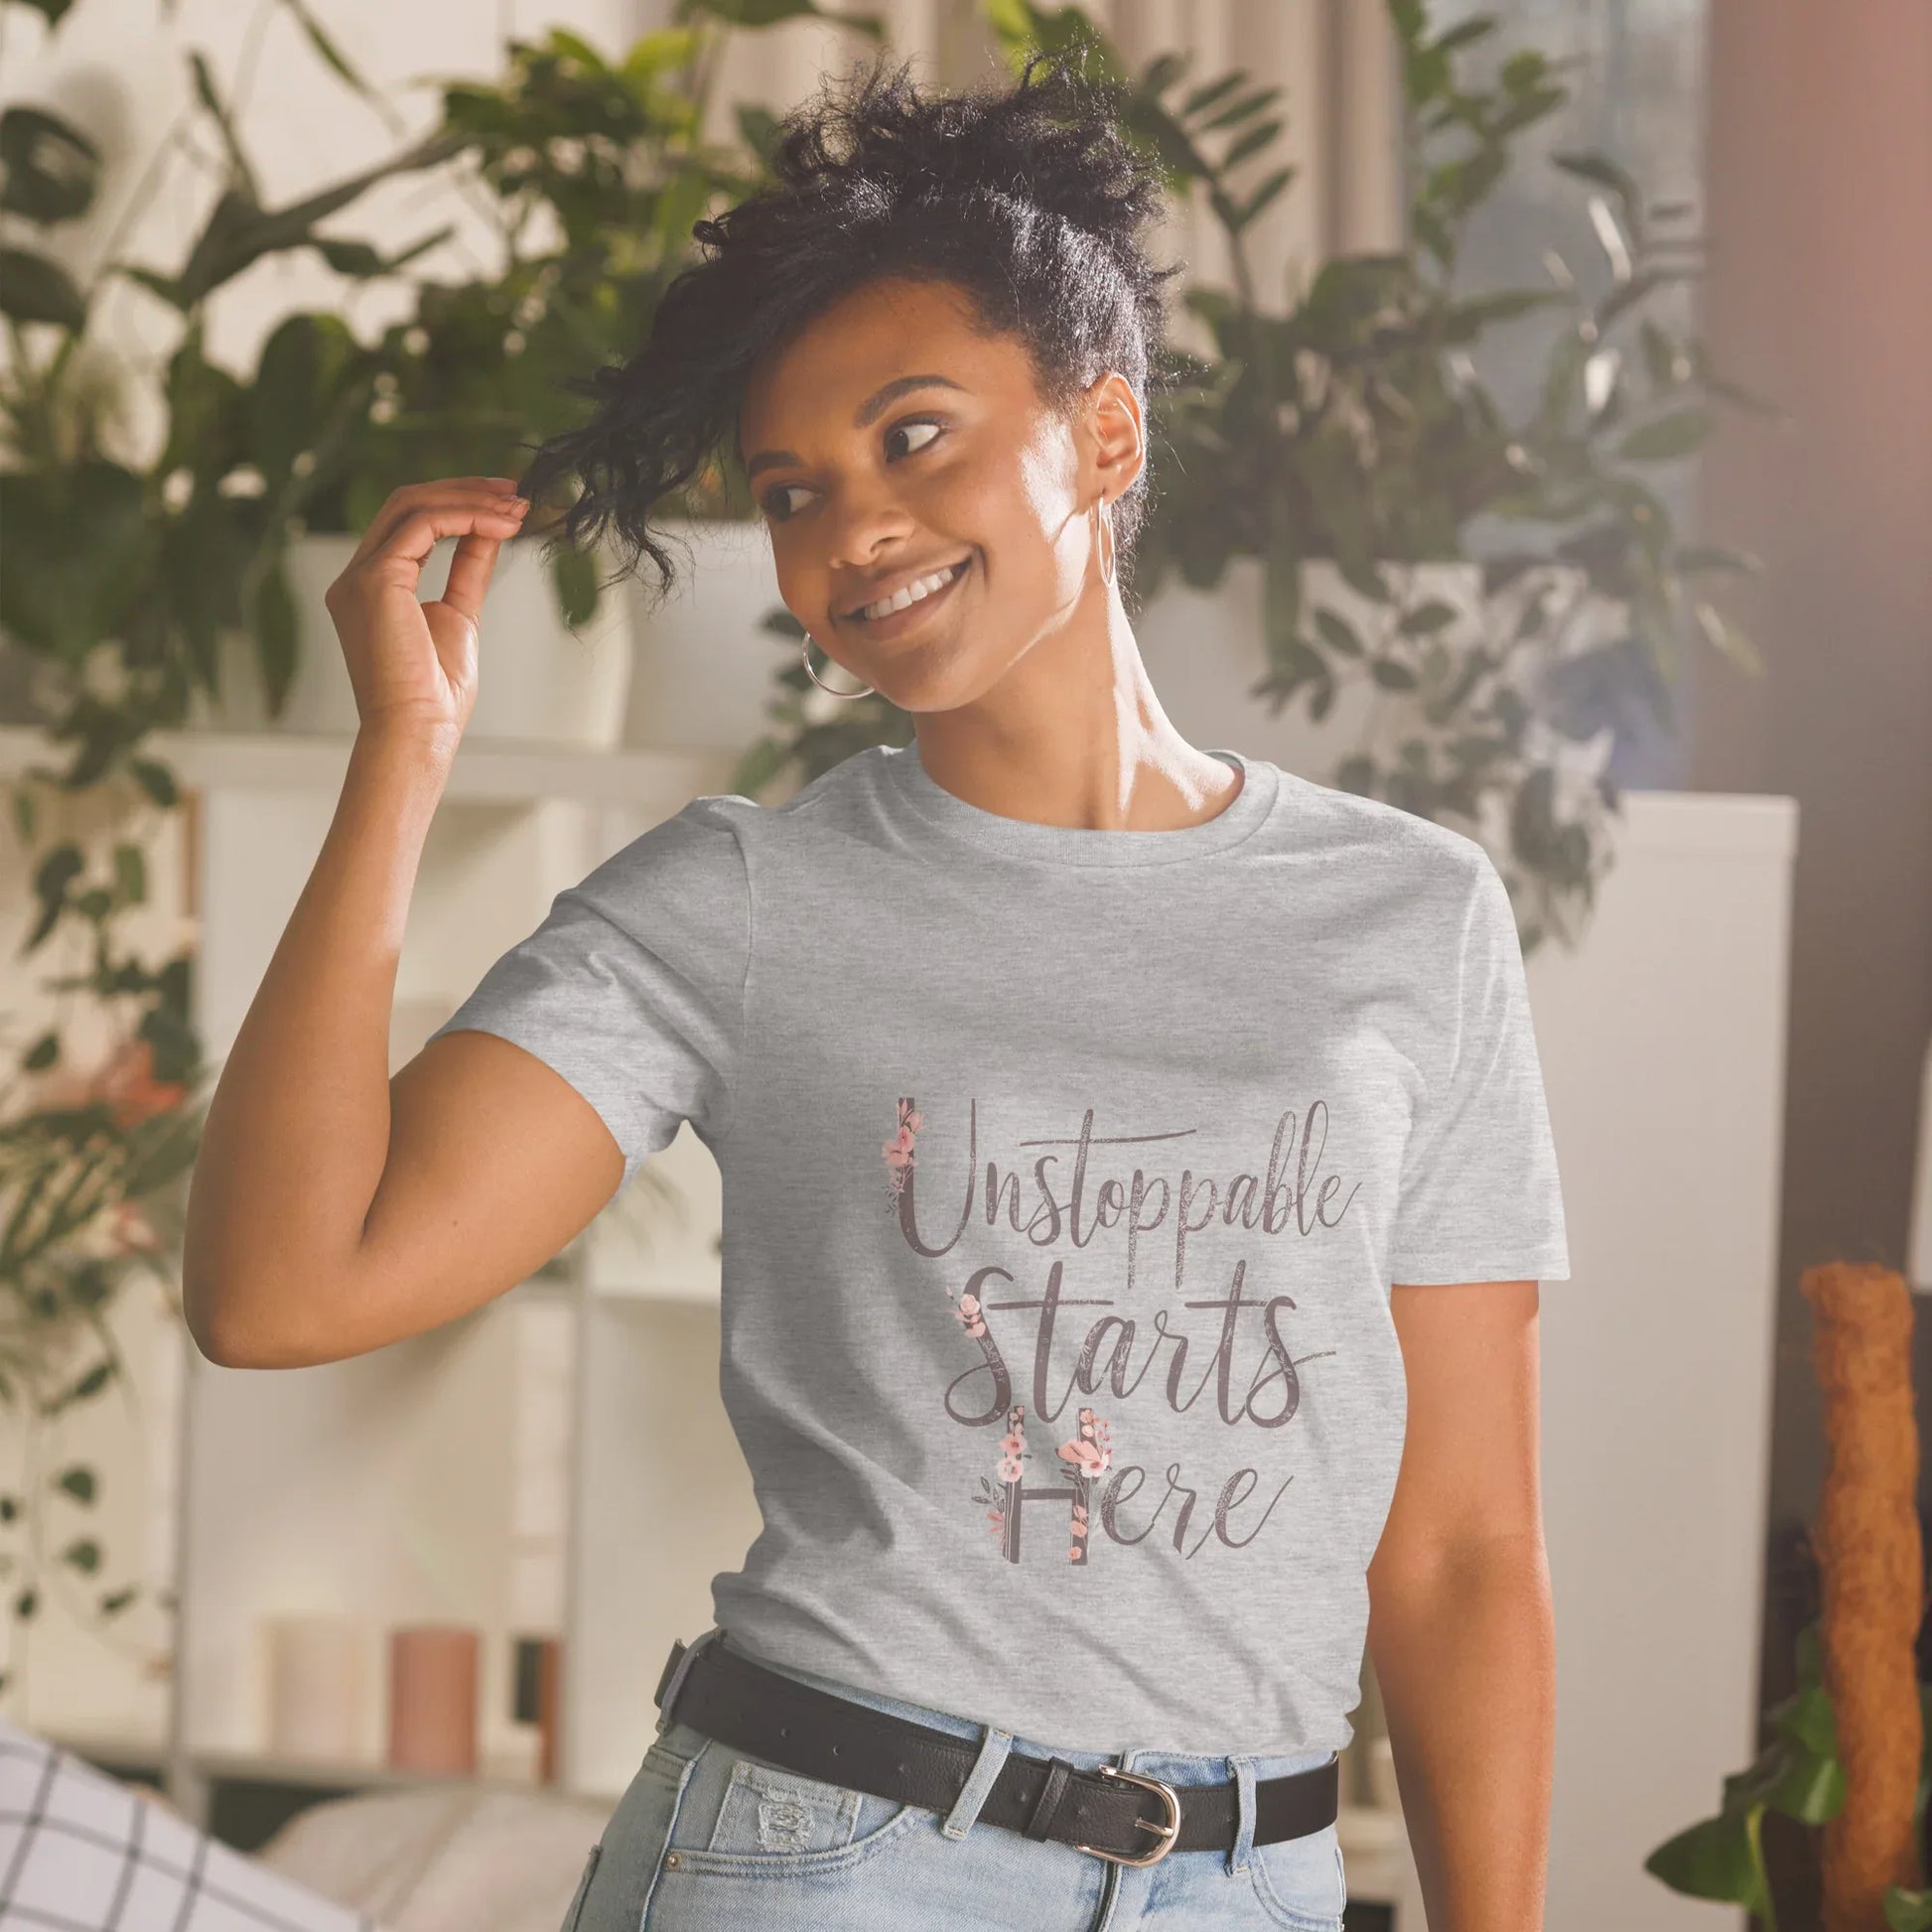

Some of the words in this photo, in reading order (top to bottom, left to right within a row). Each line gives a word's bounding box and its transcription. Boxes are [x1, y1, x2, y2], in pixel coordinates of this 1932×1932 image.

[897, 1096, 1362, 1290] Unstoppable
[944, 1259, 1337, 1429] Starts
[996, 1405, 1295, 1567] Here
